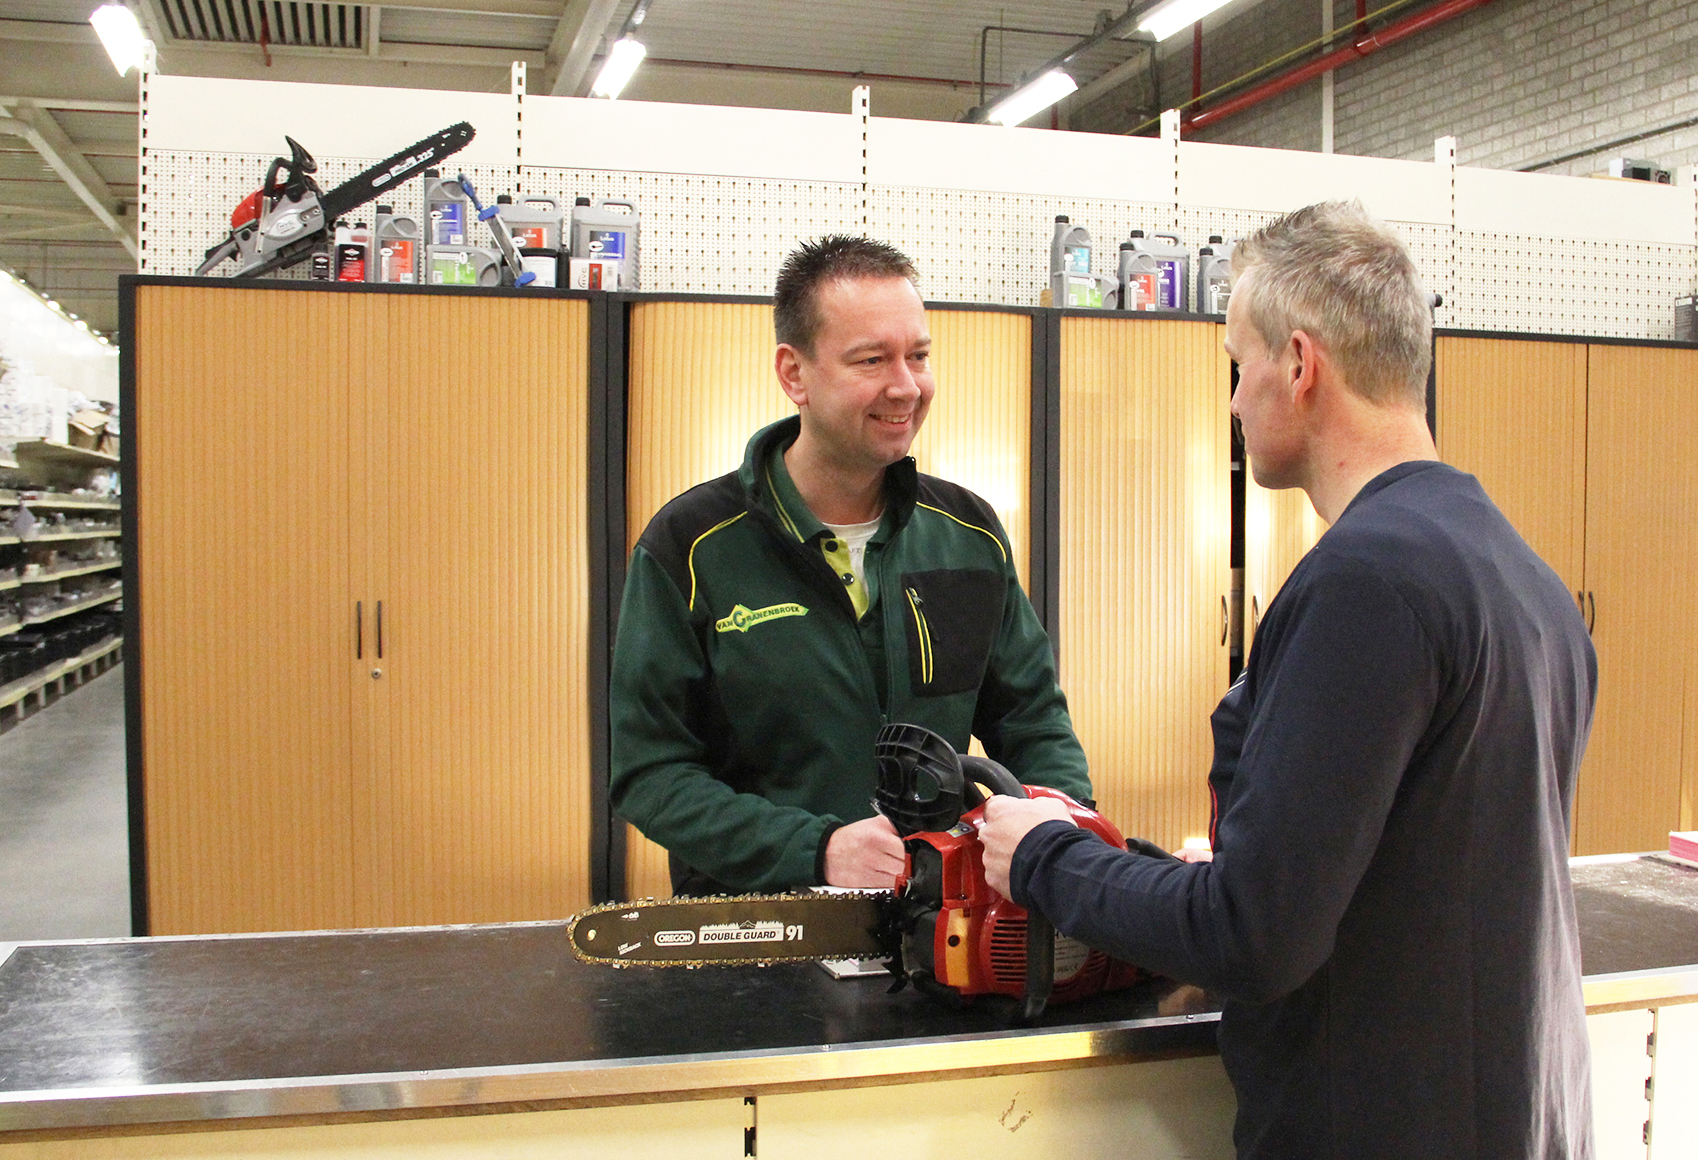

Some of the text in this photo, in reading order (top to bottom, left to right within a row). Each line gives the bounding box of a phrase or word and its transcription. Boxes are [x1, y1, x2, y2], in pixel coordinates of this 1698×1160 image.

[716, 620, 734, 630] VAN
[658, 934, 692, 943] OREGON
[703, 931, 742, 941] DOUBLE
[785, 924, 804, 941] 91
